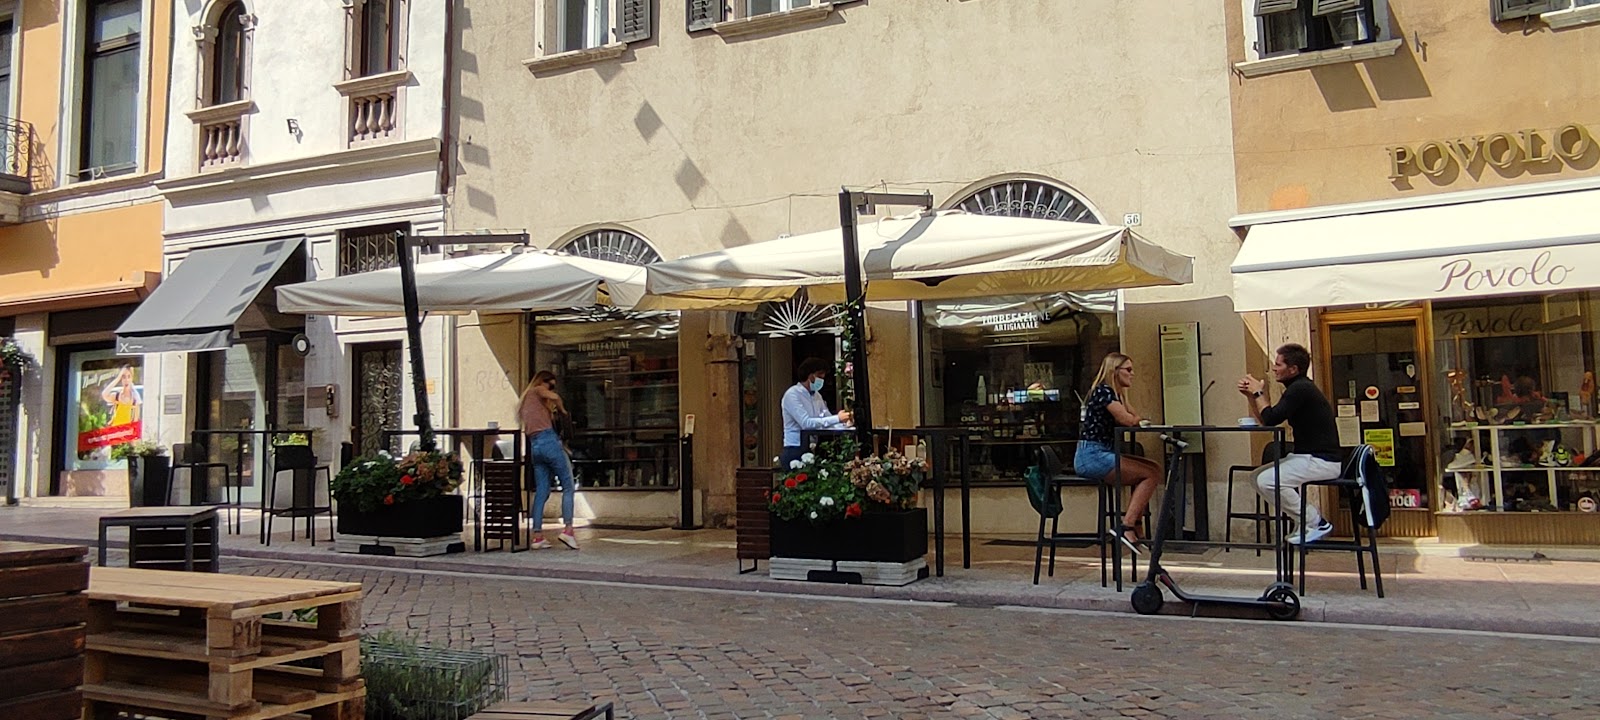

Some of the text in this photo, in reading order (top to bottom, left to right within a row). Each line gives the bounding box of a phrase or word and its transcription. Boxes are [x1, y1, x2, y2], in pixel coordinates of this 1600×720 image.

[1385, 122, 1593, 181] POVOLO
[1435, 250, 1575, 292] Povolo
[981, 311, 1051, 325] TORREFAZIONE
[993, 321, 1039, 332] ARTIGIANALE
[1388, 495, 1416, 508] TOCK
